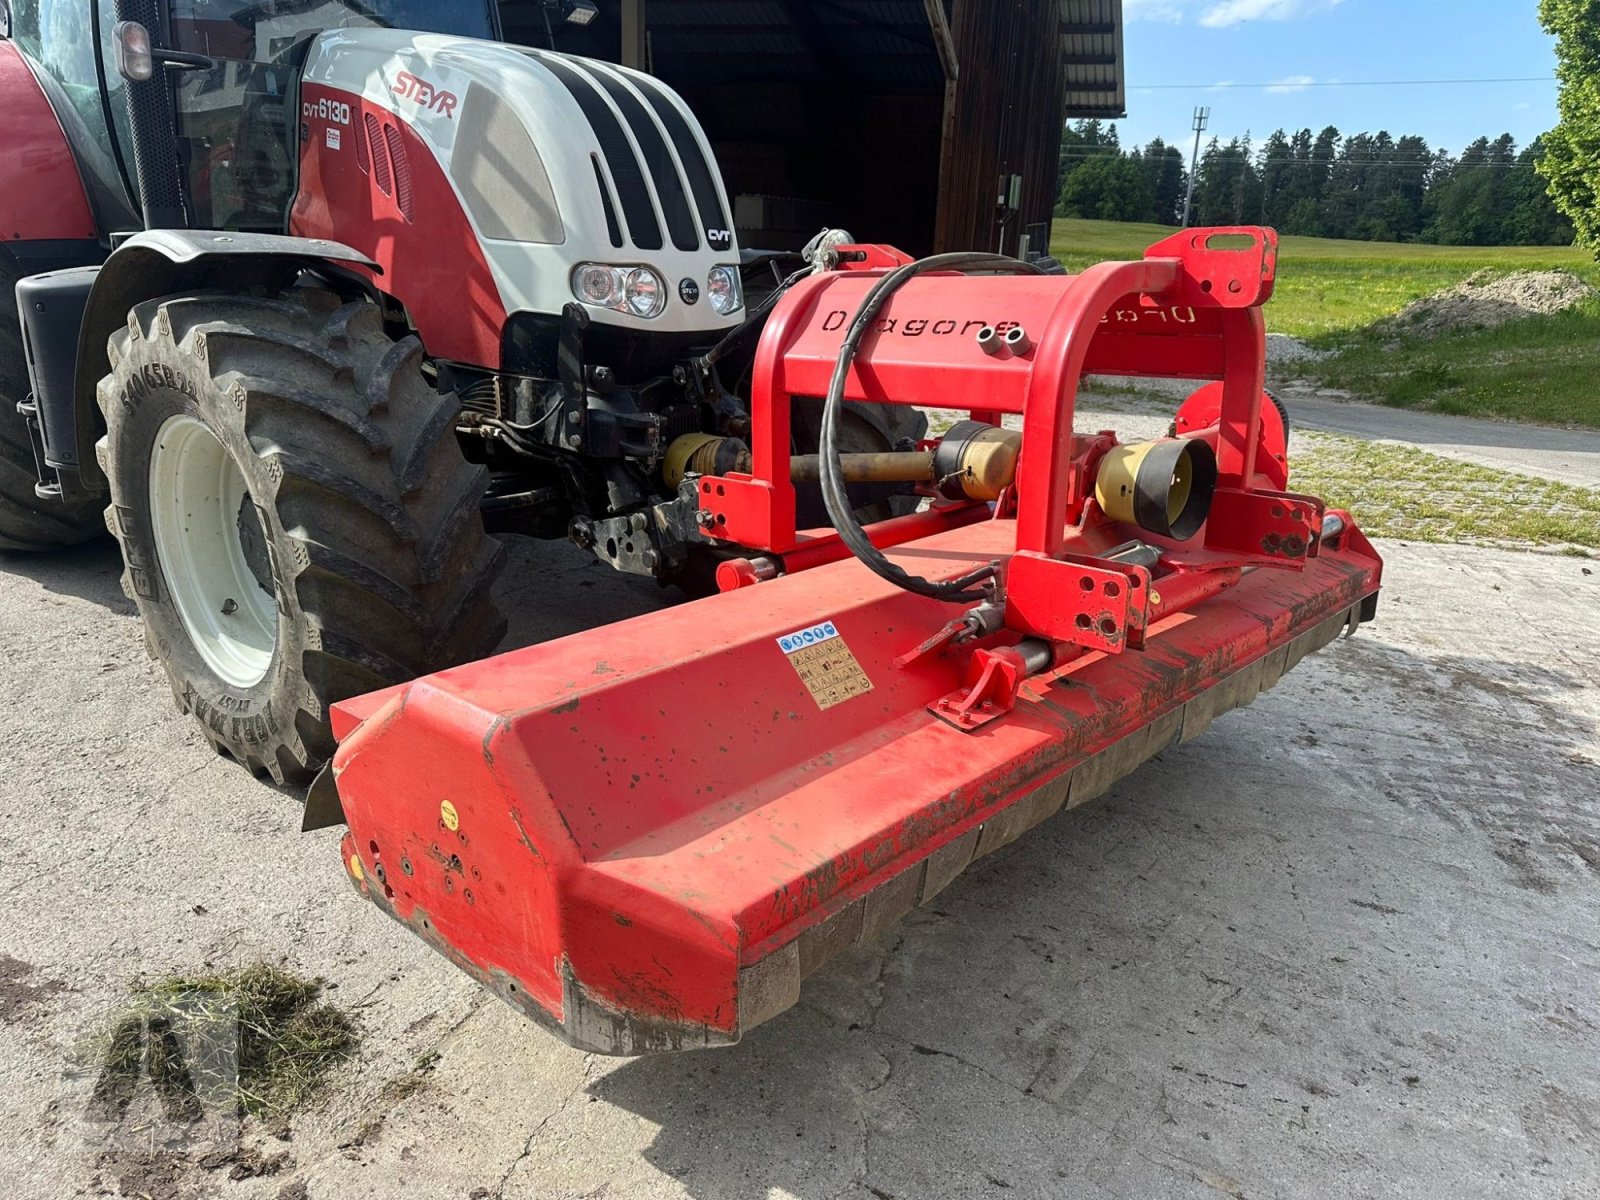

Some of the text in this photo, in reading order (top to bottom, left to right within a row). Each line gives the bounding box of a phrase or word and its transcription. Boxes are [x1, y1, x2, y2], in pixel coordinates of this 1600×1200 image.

[391, 70, 458, 119] STEYR
[303, 97, 350, 125] CVT 6130
[707, 228, 730, 242] CVT
[821, 310, 1021, 337] Dagone
